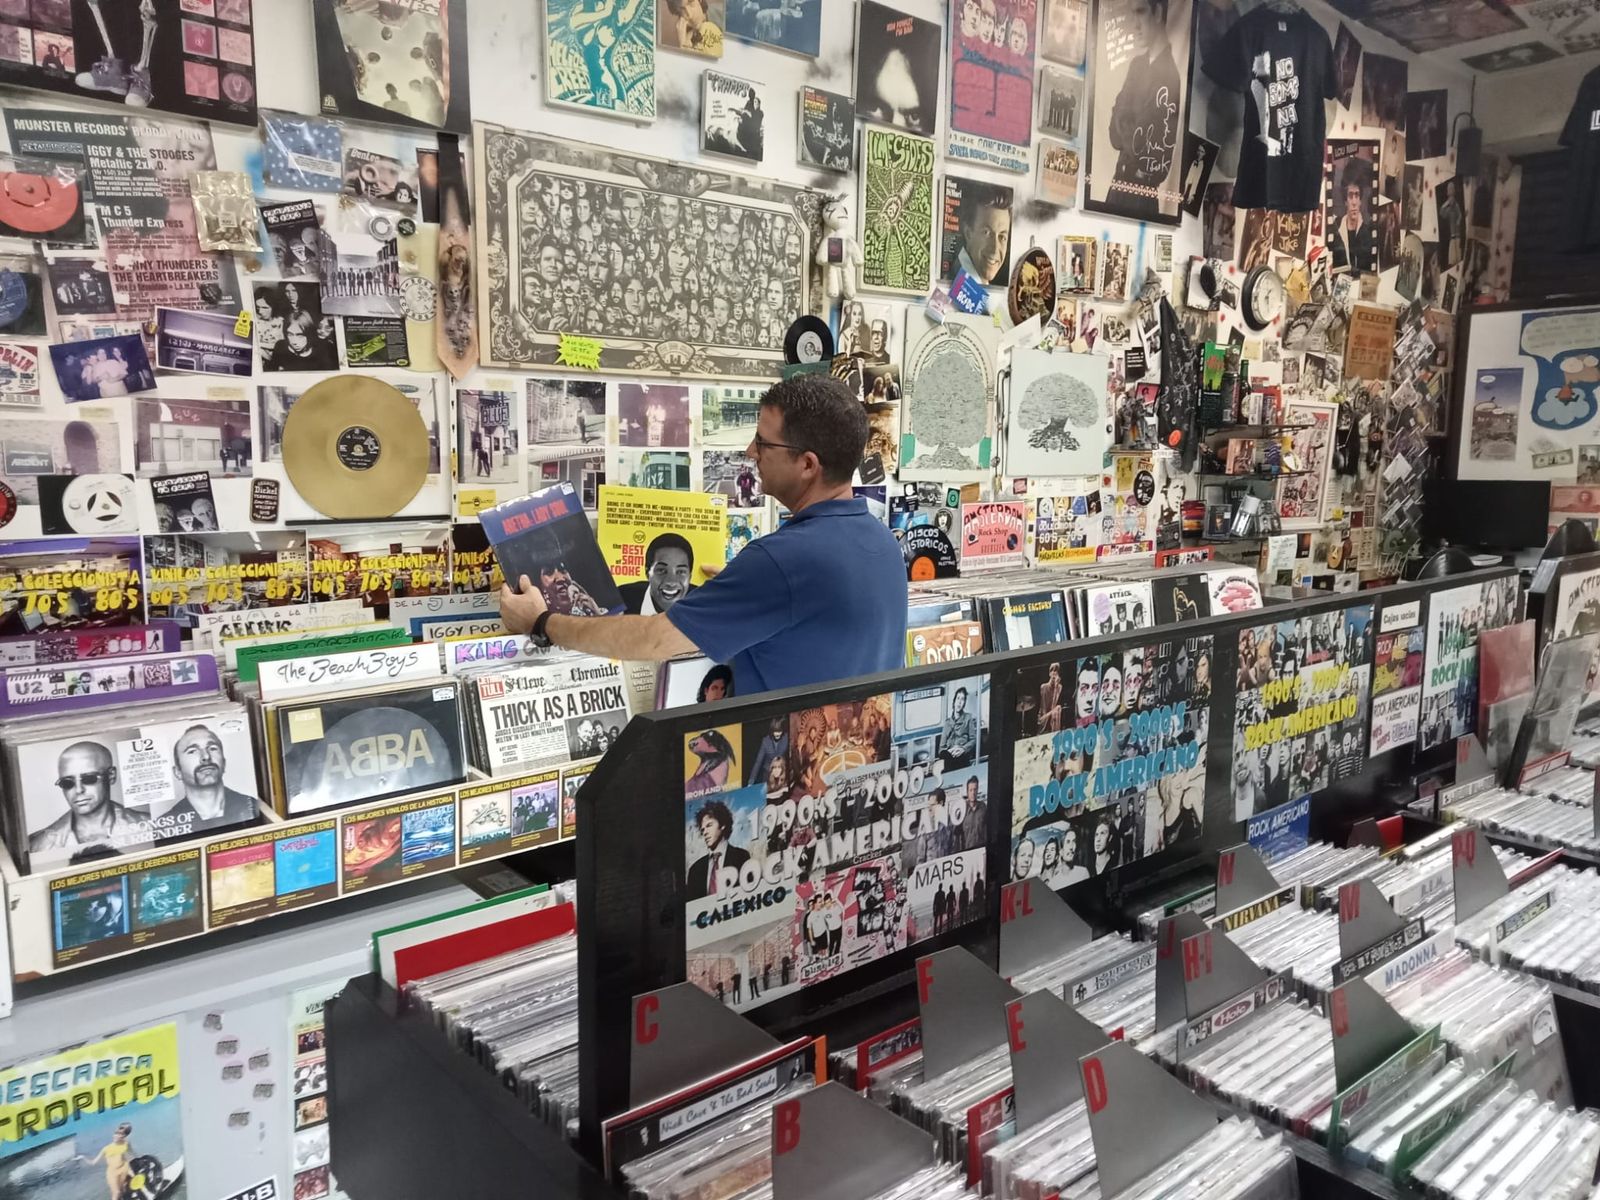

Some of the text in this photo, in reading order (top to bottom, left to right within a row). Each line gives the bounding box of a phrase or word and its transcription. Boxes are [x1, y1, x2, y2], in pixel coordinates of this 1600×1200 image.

[14, 118, 72, 134] MUNSTER
[87, 144, 196, 162] IGGY & THE STOOGES
[91, 156, 134, 170] Metallic
[101, 206, 132, 217] M C 5
[102, 216, 185, 230] Thunder Express
[115, 270, 219, 283] THE HEARTBREAKERS
[156, 260, 208, 272] THUNDERS
[907, 527, 940, 543] DISCOS
[622, 543, 645, 555] BEST
[900, 538, 950, 556] HISTORICOS
[312, 555, 446, 574] VINILOS COLECCIONISTA
[612, 565, 642, 577] COOKE
[622, 555, 645, 568] SAM
[23, 570, 139, 591] COLECCIONISTA
[1109, 591, 1133, 600] ATTACK
[430, 622, 501, 641] IGGY POP
[455, 639, 519, 665] KING
[277, 651, 419, 684] The Beach Boys
[570, 663, 620, 683] Chronicle
[1431, 661, 1458, 687] ROCK
[15, 681, 43, 696] U2
[490, 685, 626, 730] THICK AS A BRICK
[1387, 692, 1419, 714] AMERICANO
[1245, 696, 1358, 746] ROCK AMERICANO
[132, 739, 155, 758] U2
[324, 728, 436, 781] ABBA
[1028, 740, 1201, 817] ROCK AMERICANO
[176, 811, 196, 827] OF
[344, 813, 356, 825] LOS
[356, 807, 386, 822] MEJORES
[386, 801, 411, 817] VINILOS
[1249, 800, 1310, 839] ROCK AMERICANO
[207, 843, 221, 855] LOS
[221, 836, 250, 852] MEJORES
[715, 799, 968, 895] ROCK AMERICANO
[52, 878, 68, 890] LOS
[68, 871, 101, 888] MEJORES
[101, 864, 129, 880] VINILOS
[129, 860, 144, 874] QUE
[178, 848, 201, 862] TENER
[914, 857, 965, 888] MARS
[696, 885, 786, 929] CALEXICO
[1001, 882, 1034, 924] K-L
[1225, 895, 1280, 932] NIRVANA
[1384, 942, 1438, 987] MADONNA
[917, 958, 934, 1004] F
[635, 994, 660, 1046] C
[1007, 1002, 1027, 1053] E
[1082, 1056, 1108, 1115] D
[661, 1116, 684, 1136] Nick
[686, 1102, 708, 1125] Cave
[736, 1083, 755, 1104] Bad
[775, 1098, 801, 1156] B
